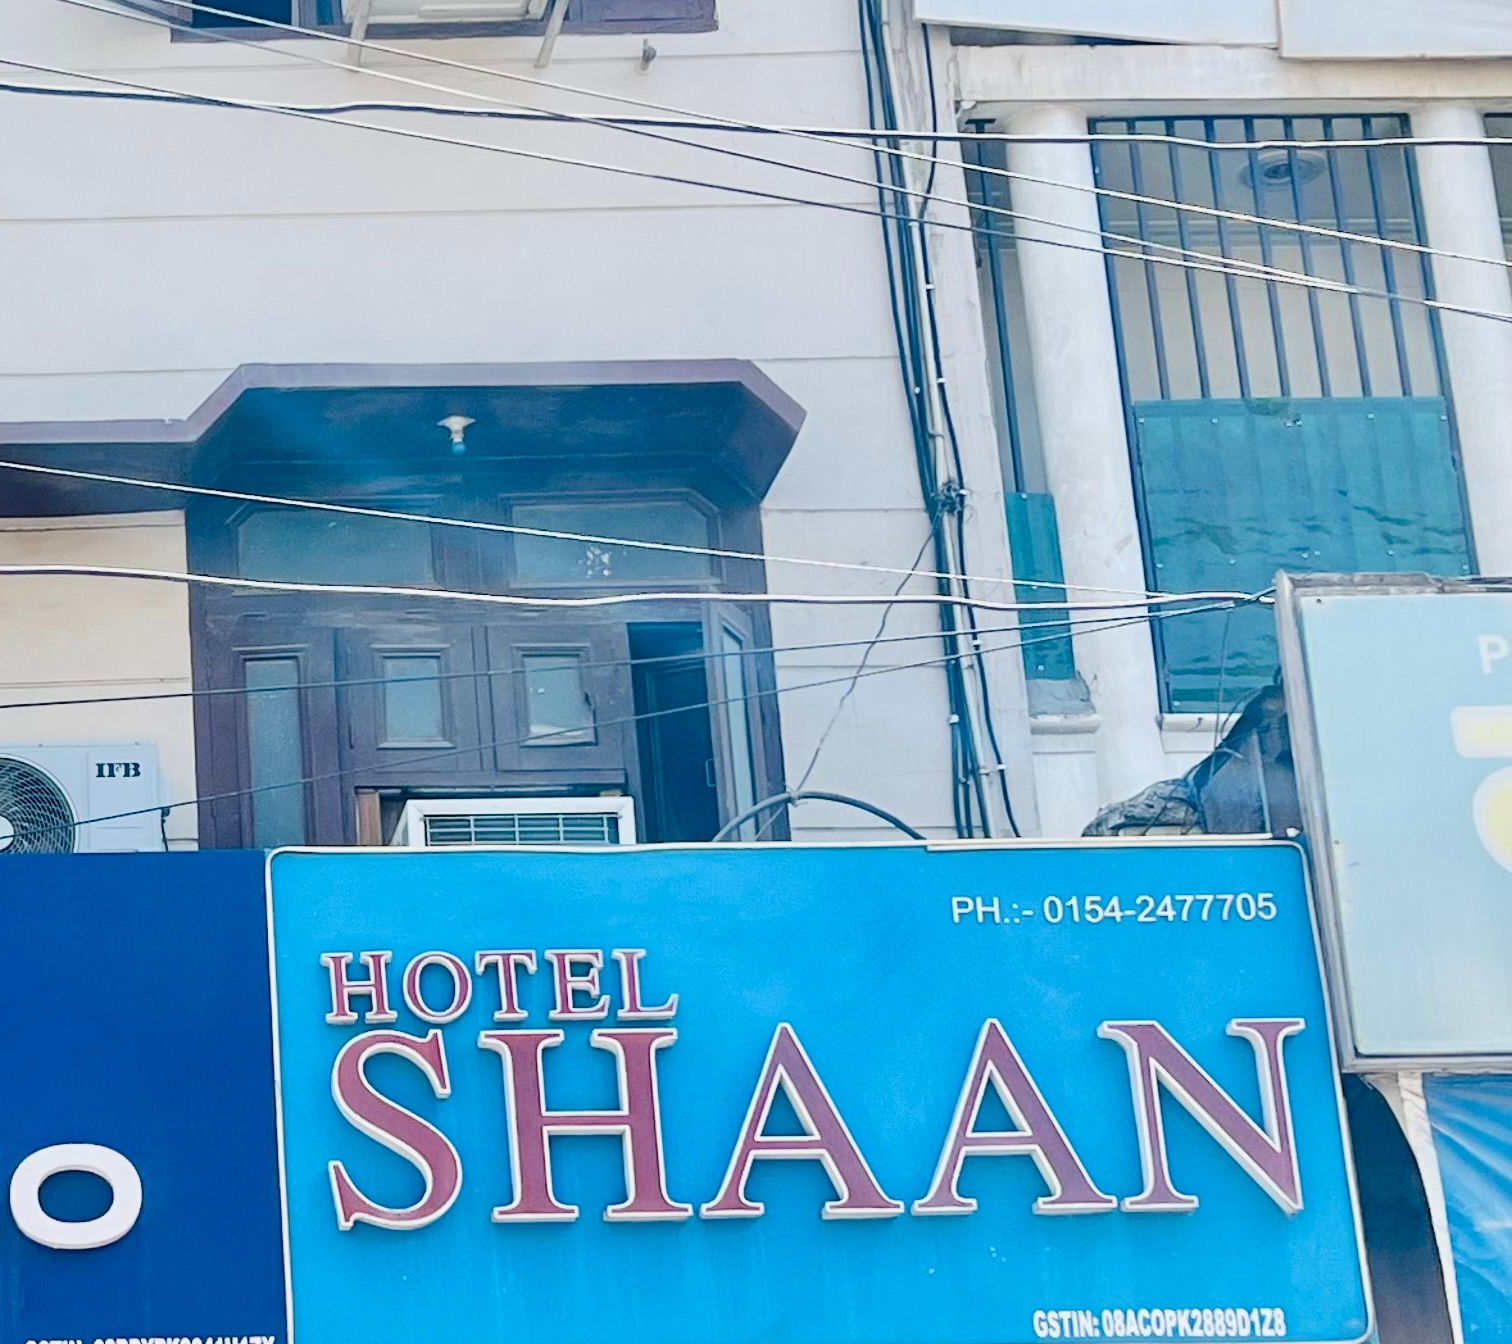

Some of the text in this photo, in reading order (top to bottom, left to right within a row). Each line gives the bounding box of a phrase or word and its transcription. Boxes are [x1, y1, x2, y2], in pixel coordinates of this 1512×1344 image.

[95, 762, 141, 778] IFB
[1044, 893, 1277, 922] 0154-2477705
[321, 949, 678, 1024] HOTEL
[329, 1018, 1306, 1231] SHAAN
[1034, 1309, 1100, 1338] GSTIN:
